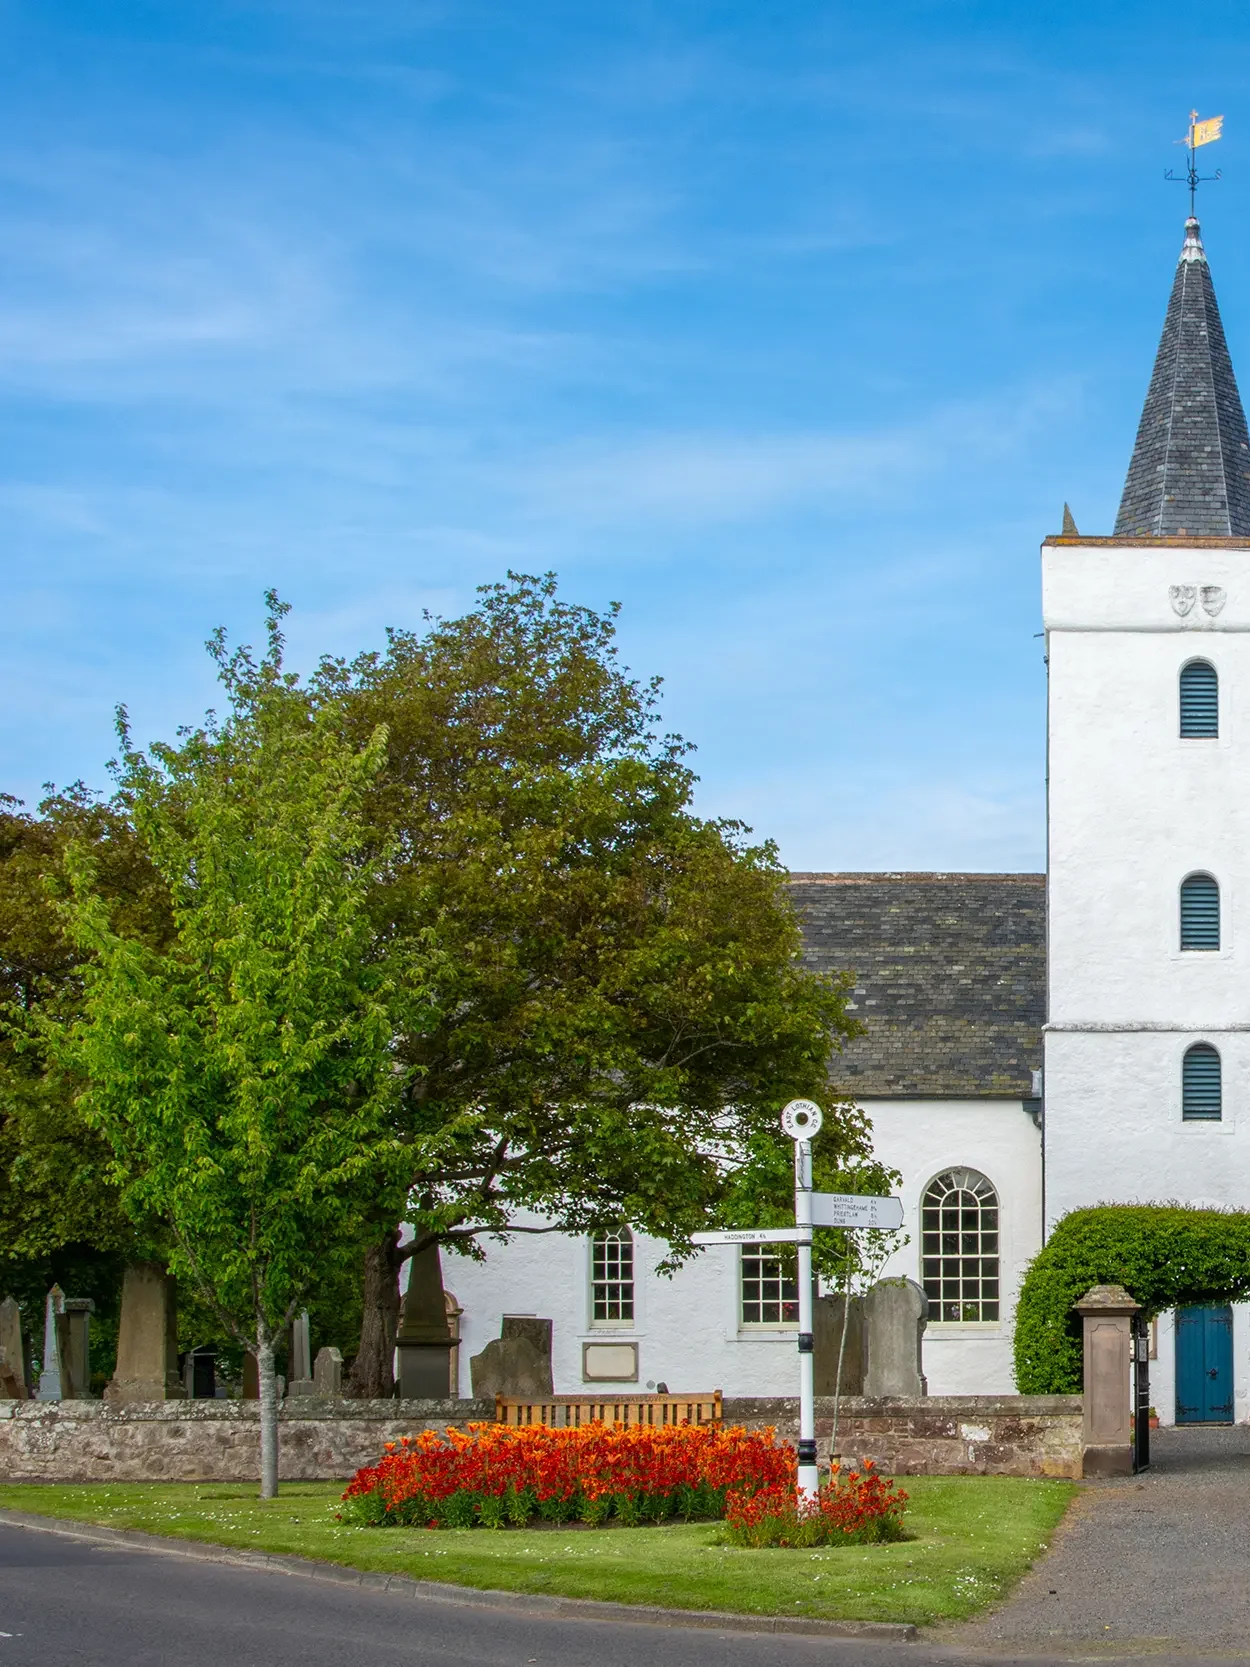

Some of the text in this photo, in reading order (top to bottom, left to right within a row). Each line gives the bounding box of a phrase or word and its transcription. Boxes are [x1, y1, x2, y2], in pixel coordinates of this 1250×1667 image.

[785, 1112, 794, 1129] EAST
[791, 1102, 817, 1117] LOTHIAN
[724, 1233, 755, 1241] HADDINGTON
[615, 1395, 643, 1403] ALWAYS
